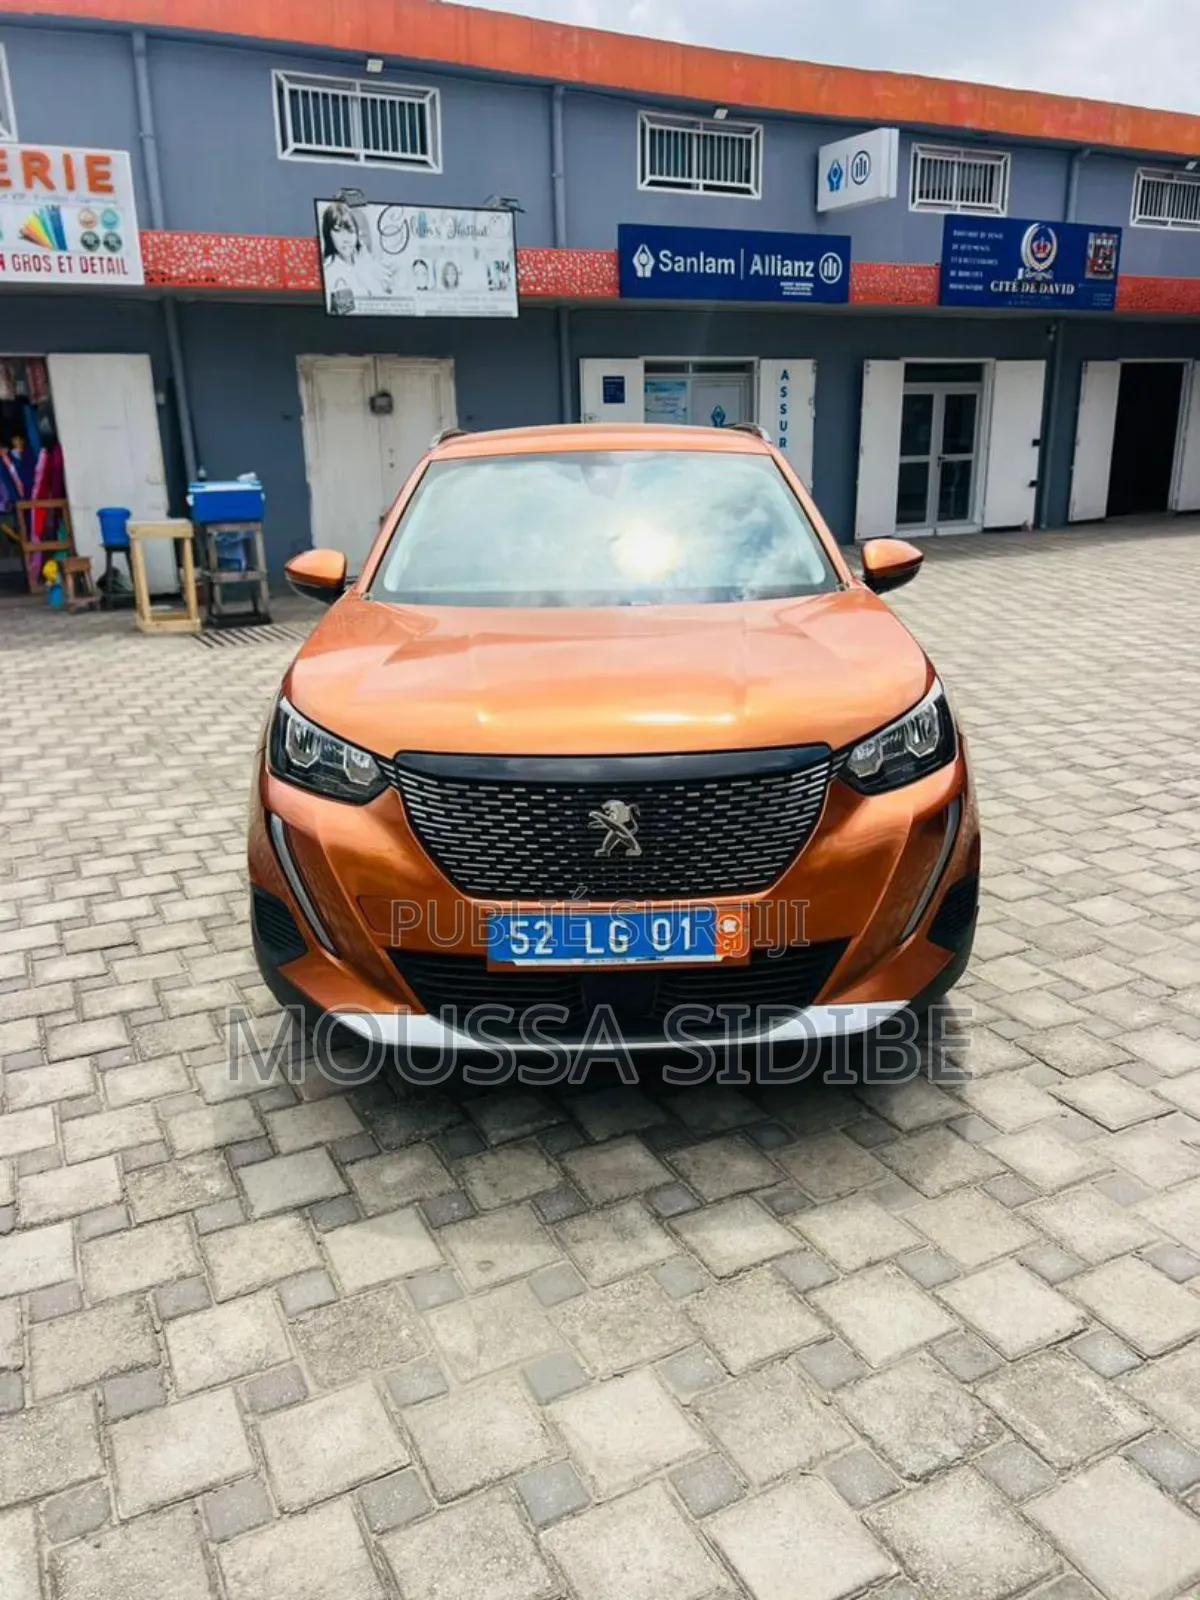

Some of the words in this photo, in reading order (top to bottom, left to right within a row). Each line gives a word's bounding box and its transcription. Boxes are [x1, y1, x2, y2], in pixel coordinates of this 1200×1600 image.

[11, 253, 52, 273] GROS
[57, 255, 75, 273] ET
[80, 256, 129, 275] DETAIL
[659, 249, 735, 275] Sanlam
[750, 253, 815, 278] Allianz
[1020, 281, 1037, 294] DE
[1038, 282, 1076, 296] DAVID
[778, 369, 790, 449] ASSUR
[509, 920, 554, 955] 52
[585, 919, 629, 955] LG
[652, 916, 691, 952] 01
